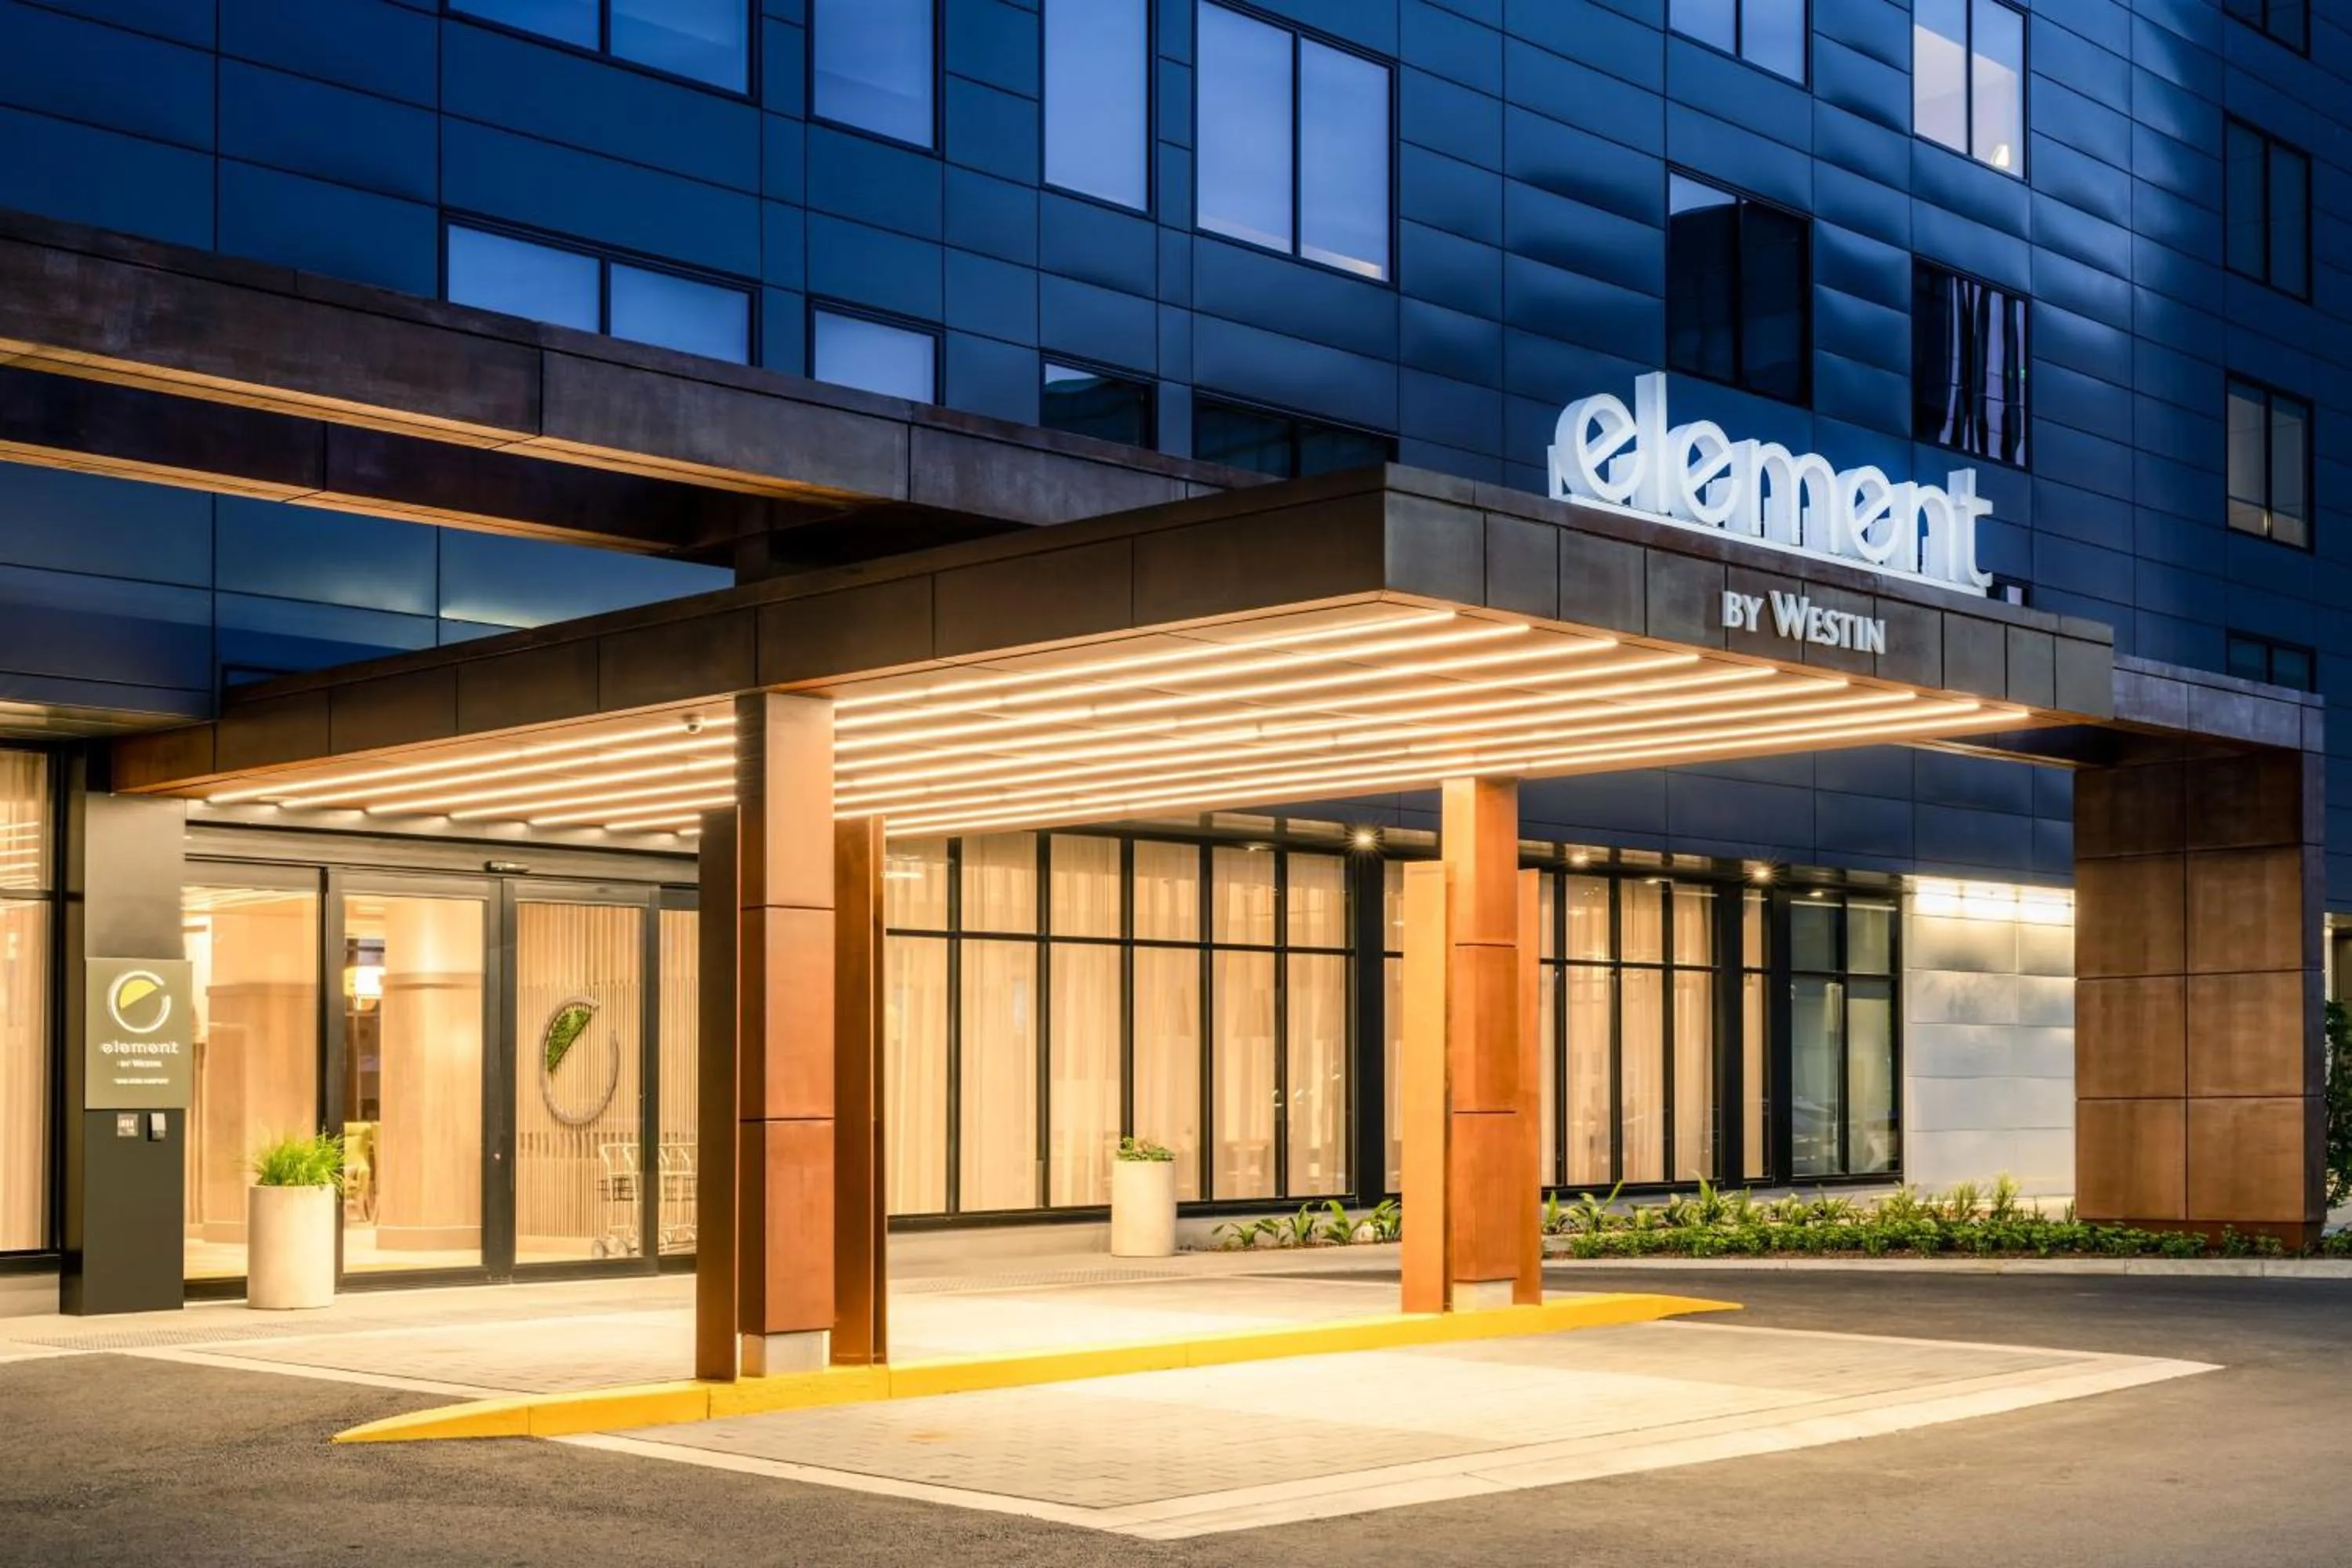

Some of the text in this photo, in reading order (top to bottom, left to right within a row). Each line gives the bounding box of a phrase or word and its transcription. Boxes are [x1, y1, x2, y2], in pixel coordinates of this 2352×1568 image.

[1552, 372, 1993, 588] element
[1722, 590, 1886, 654] BY WESTIN
[100, 1040, 180, 1054] element
